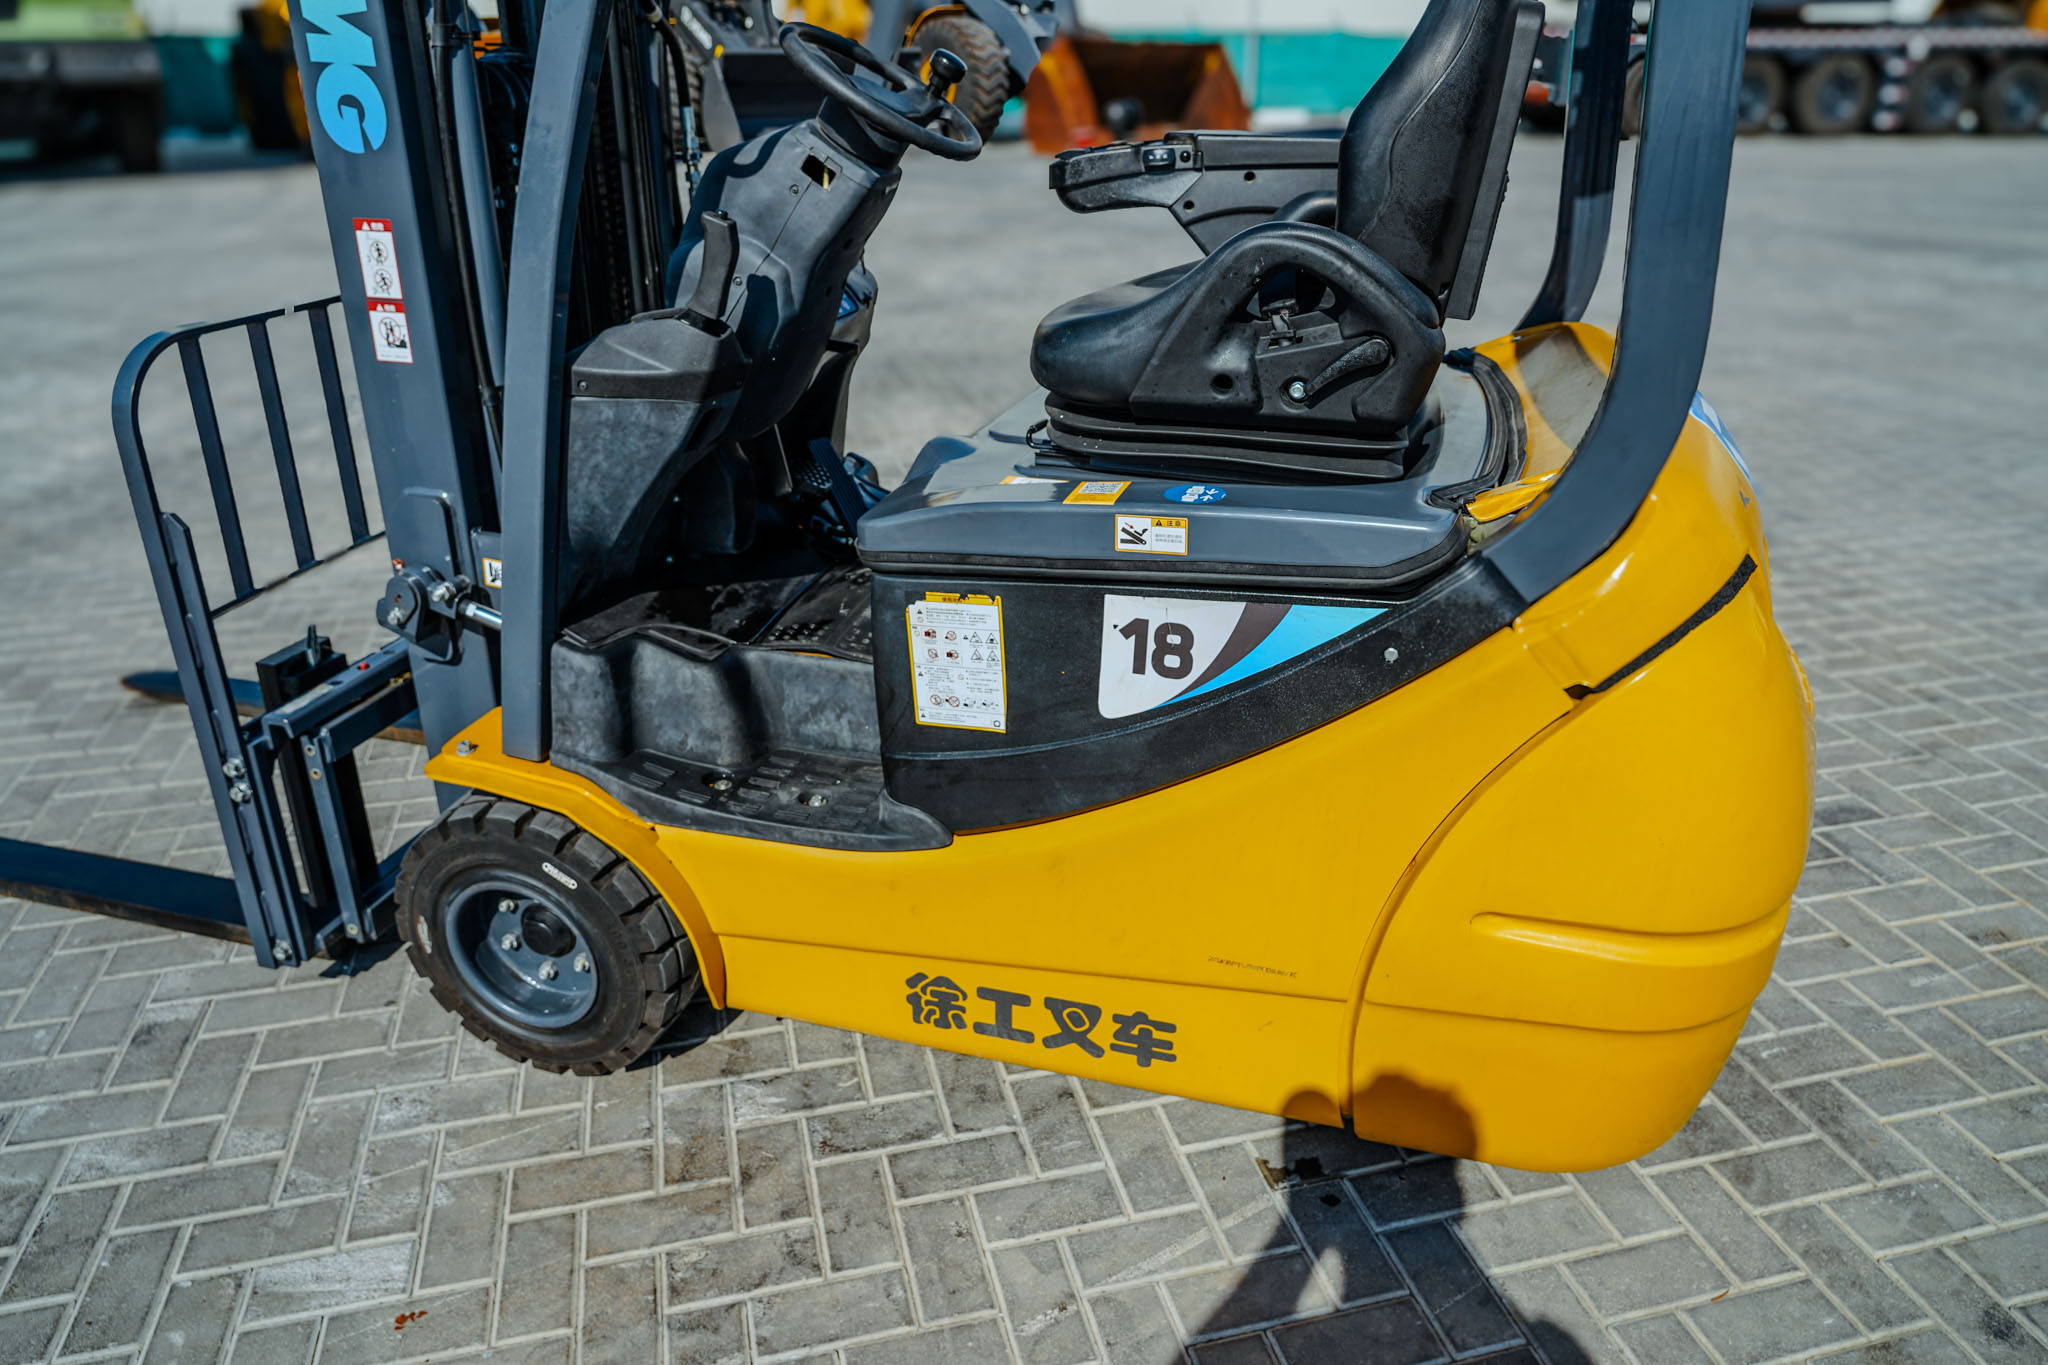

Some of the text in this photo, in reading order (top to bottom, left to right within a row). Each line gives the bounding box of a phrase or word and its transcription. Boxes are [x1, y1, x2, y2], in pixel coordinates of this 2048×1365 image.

[1119, 617, 1195, 680] 18
[905, 972, 1177, 1068] 徐工叉车
